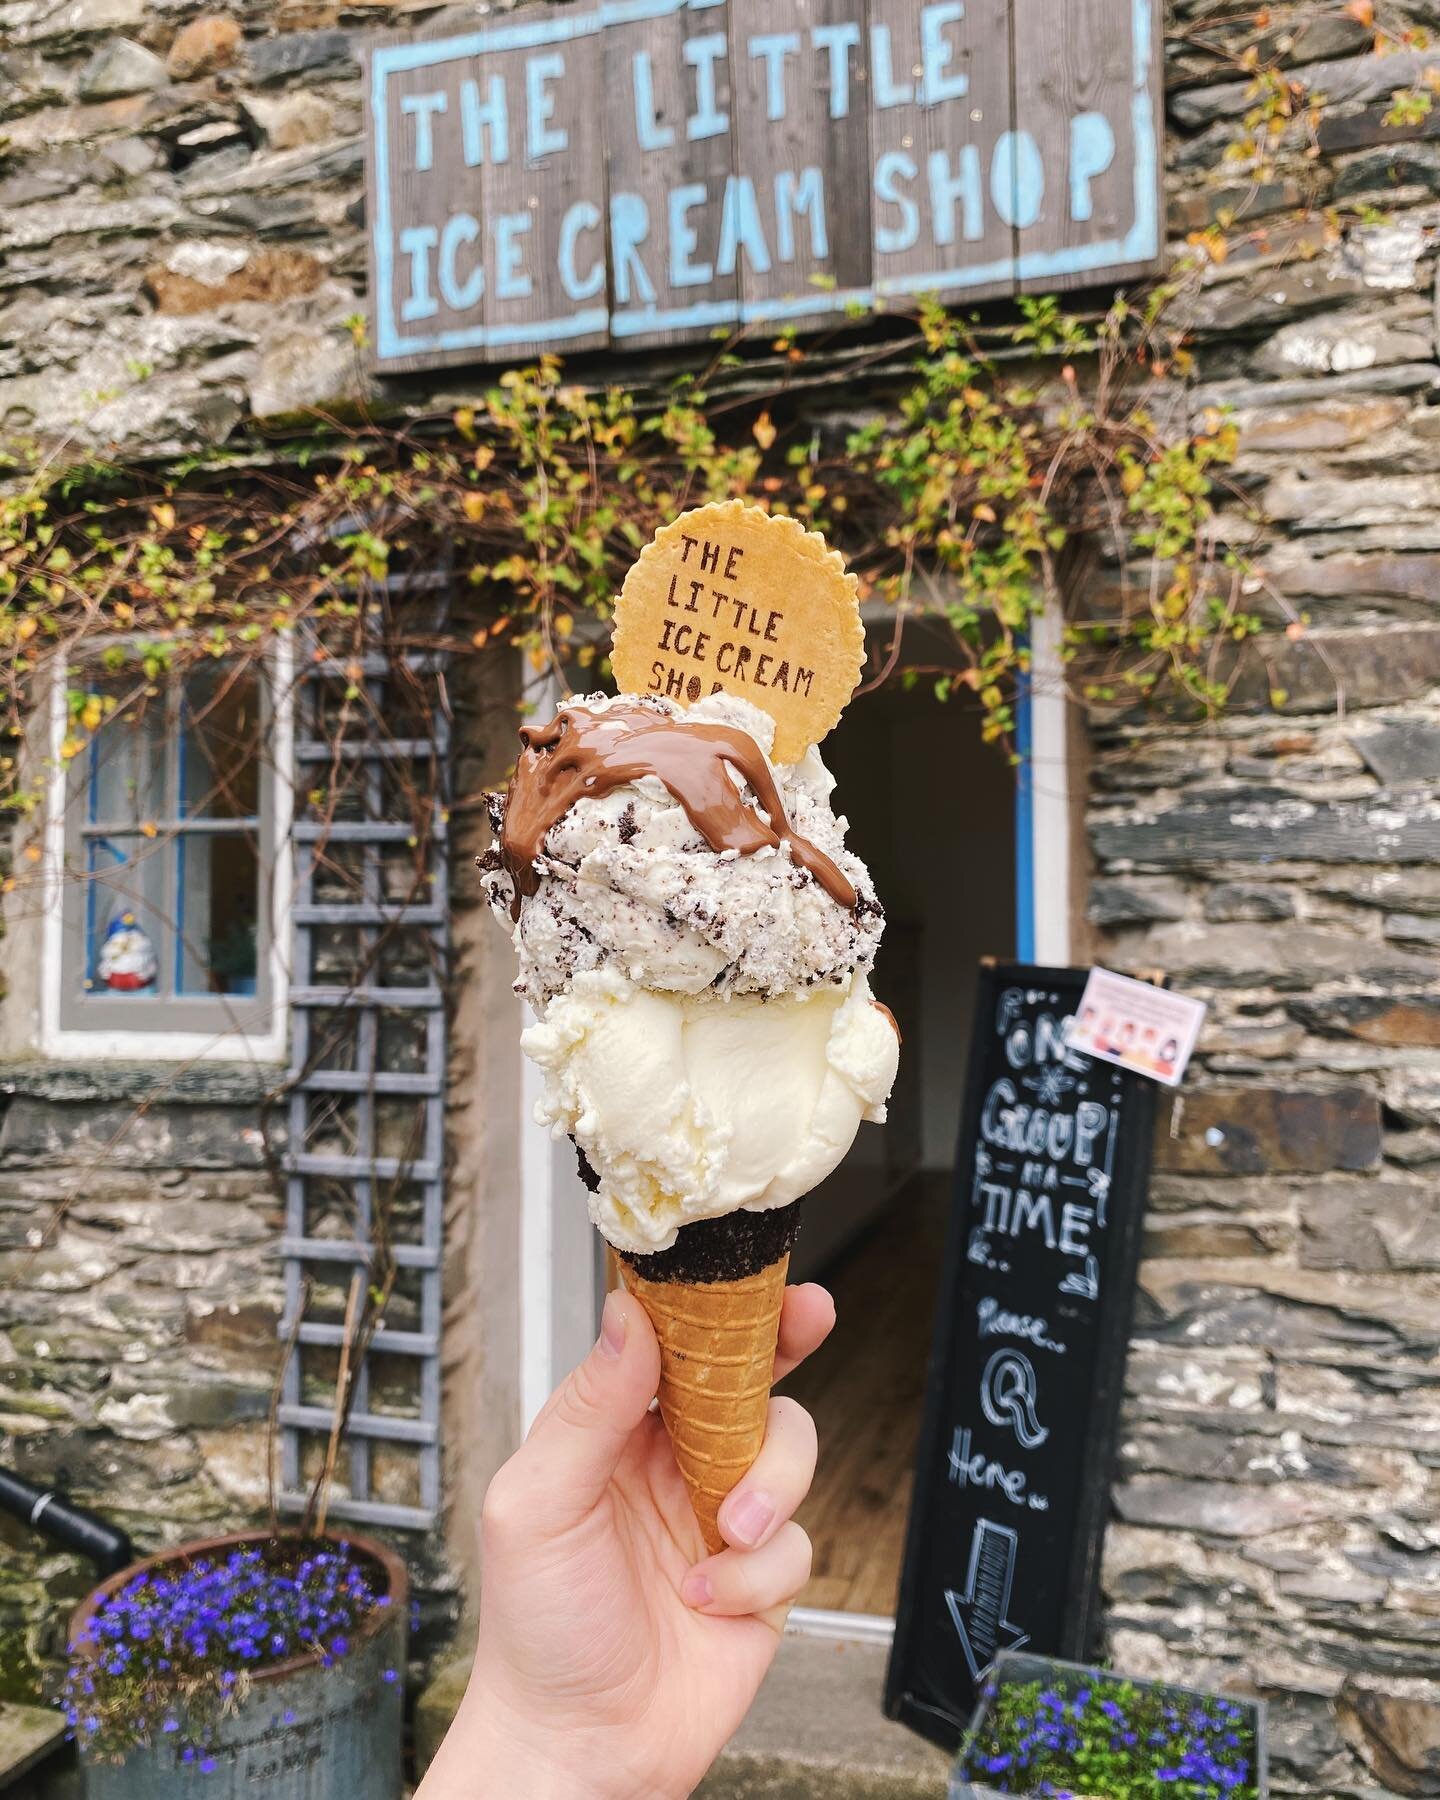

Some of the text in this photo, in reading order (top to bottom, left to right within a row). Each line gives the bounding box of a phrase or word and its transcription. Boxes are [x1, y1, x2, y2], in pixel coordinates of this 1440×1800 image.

[401, 2, 970, 171] THE LITTLE
[400, 111, 1117, 322] ICE CREAM SHOP
[681, 534, 744, 581] THE
[667, 574, 784, 643] LITTLE
[657, 619, 816, 698] ICE CREAM
[980, 1182, 1095, 1257] TIME
[979, 1347, 1049, 1450] Q
